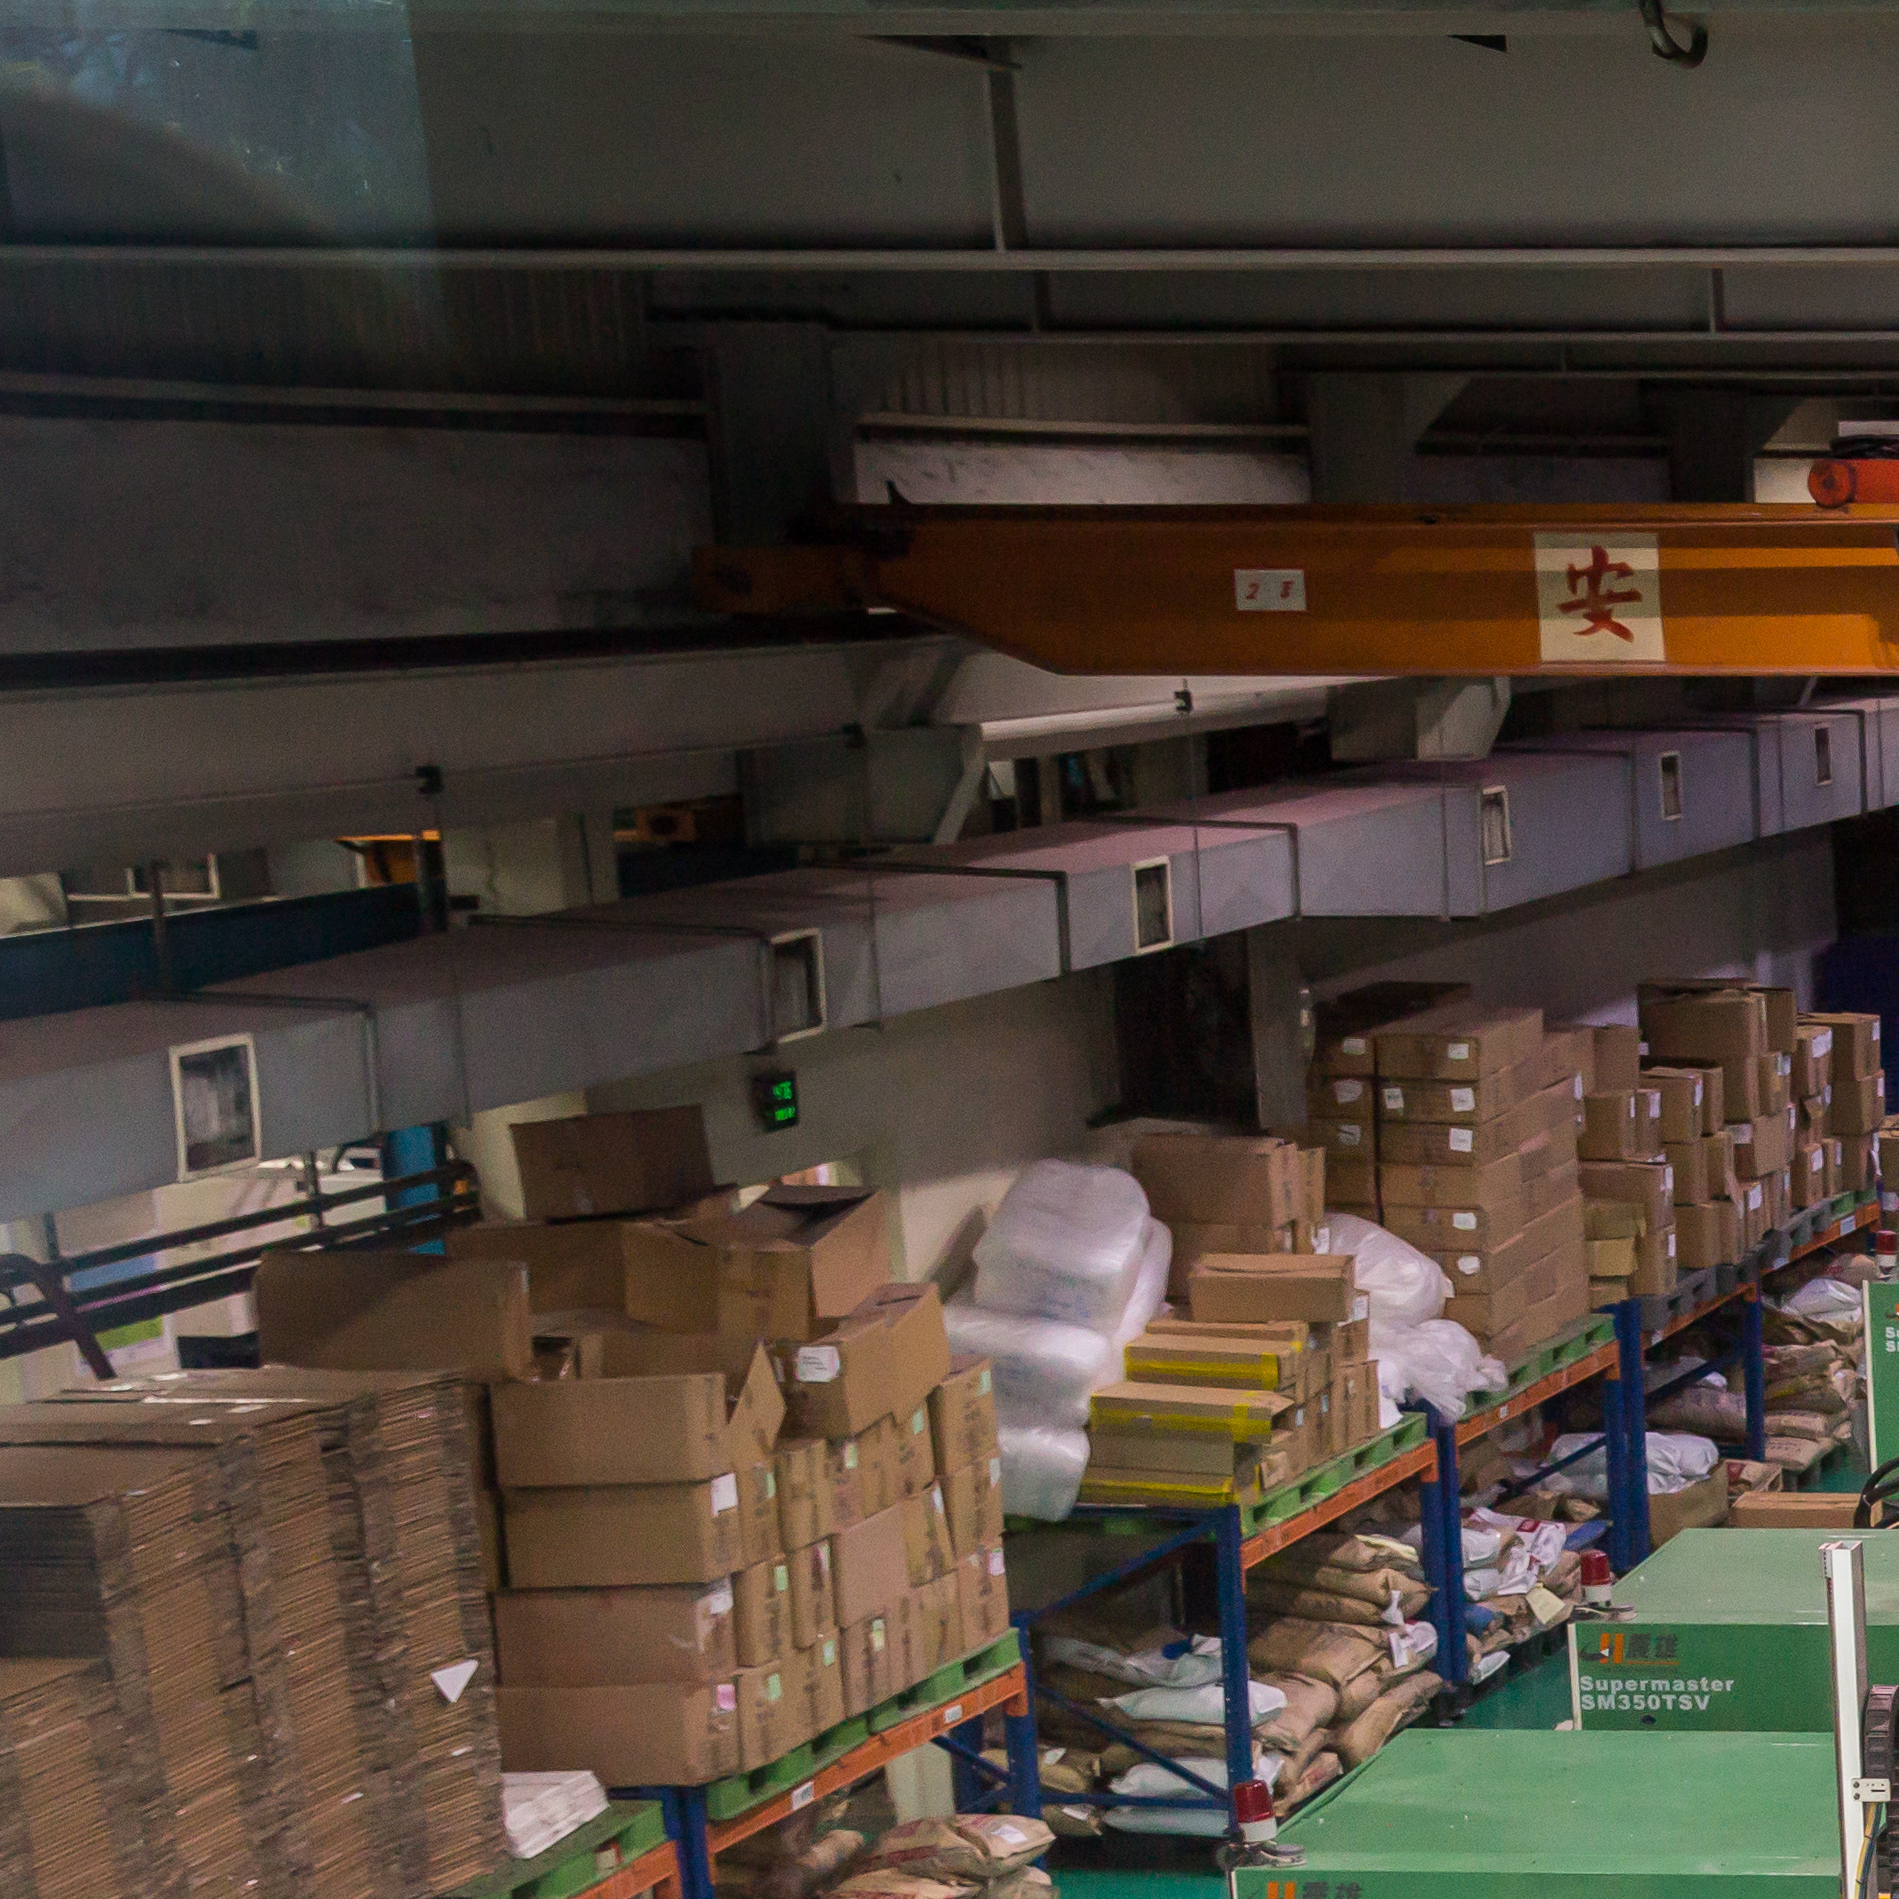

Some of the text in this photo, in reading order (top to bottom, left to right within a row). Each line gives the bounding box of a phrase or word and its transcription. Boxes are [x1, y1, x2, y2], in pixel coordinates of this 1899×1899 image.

[1557, 544, 1643, 643] 安
[1579, 1675, 1735, 1695] Supermaster
[1580, 1694, 1711, 1711] SM350TSV
